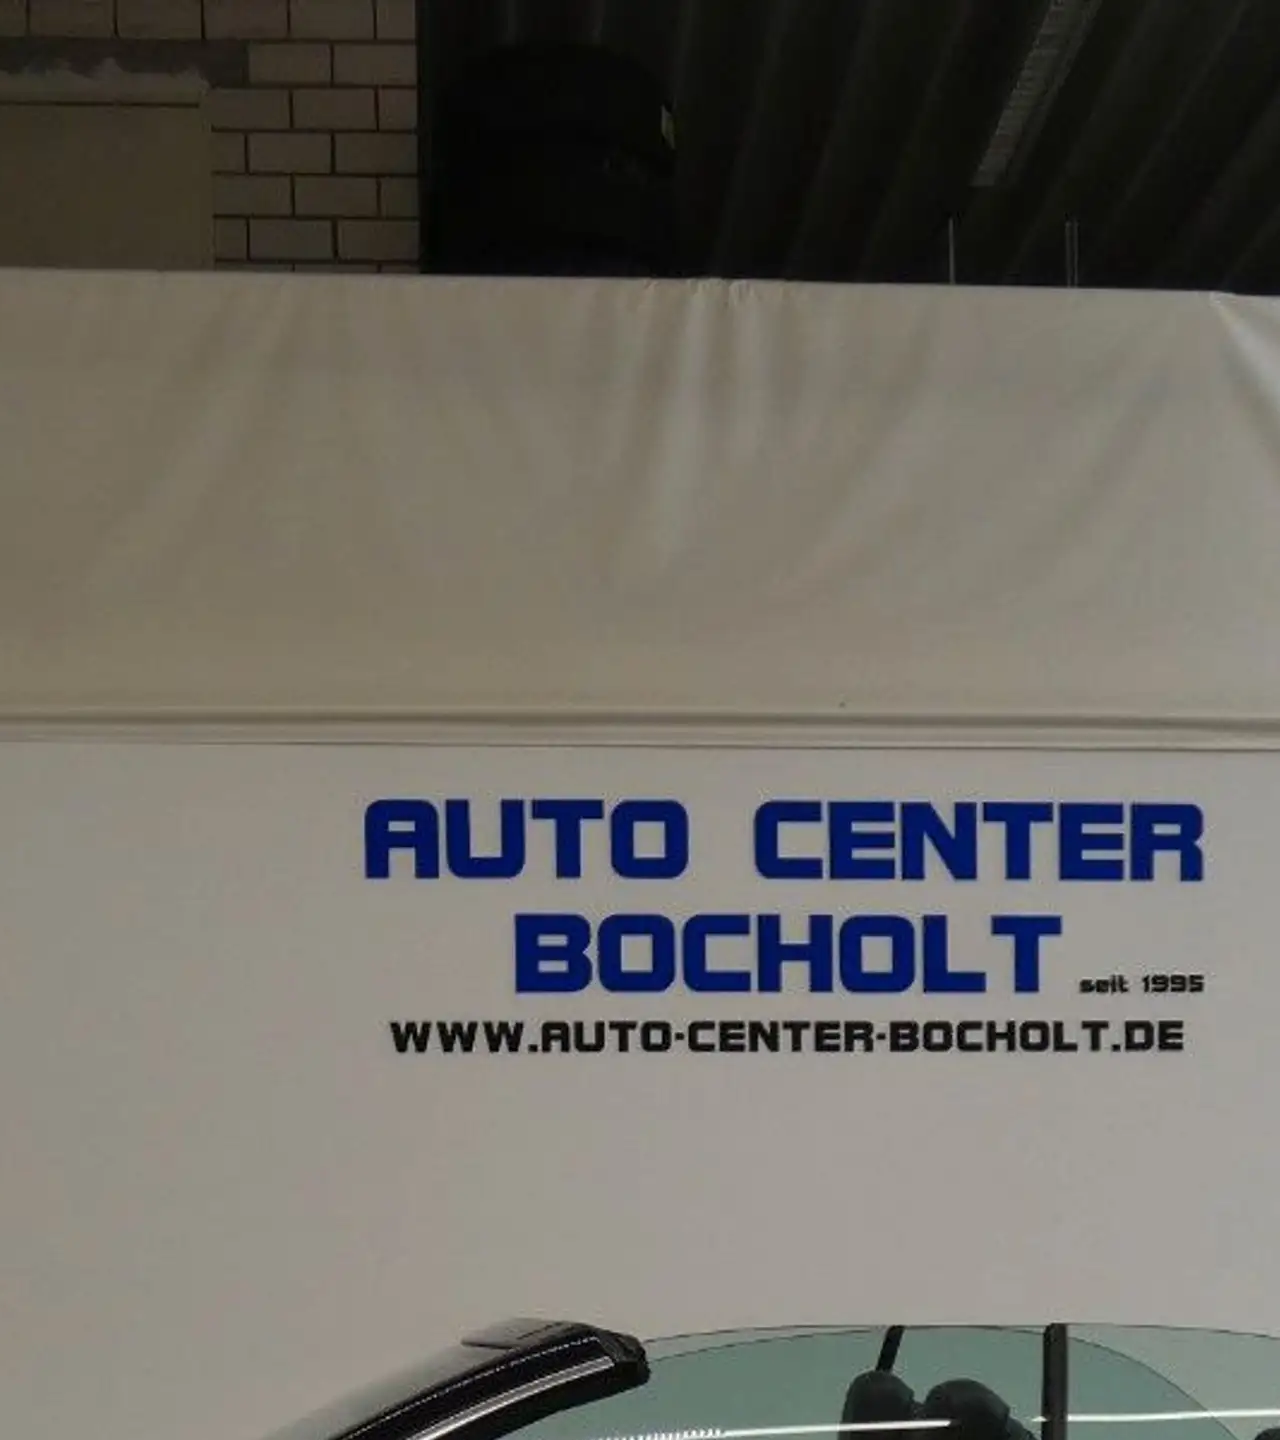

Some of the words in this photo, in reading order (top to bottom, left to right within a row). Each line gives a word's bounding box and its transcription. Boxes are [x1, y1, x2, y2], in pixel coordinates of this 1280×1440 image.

[365, 799, 688, 880] AUTO
[754, 800, 1204, 882] CENTER
[515, 913, 1062, 994] BOCHOLT
[1079, 973, 1129, 994] seit
[1141, 973, 1205, 994] 1995
[390, 1020, 1184, 1054] WWW.AUTO-CENTER-BOCHOLT.DE
